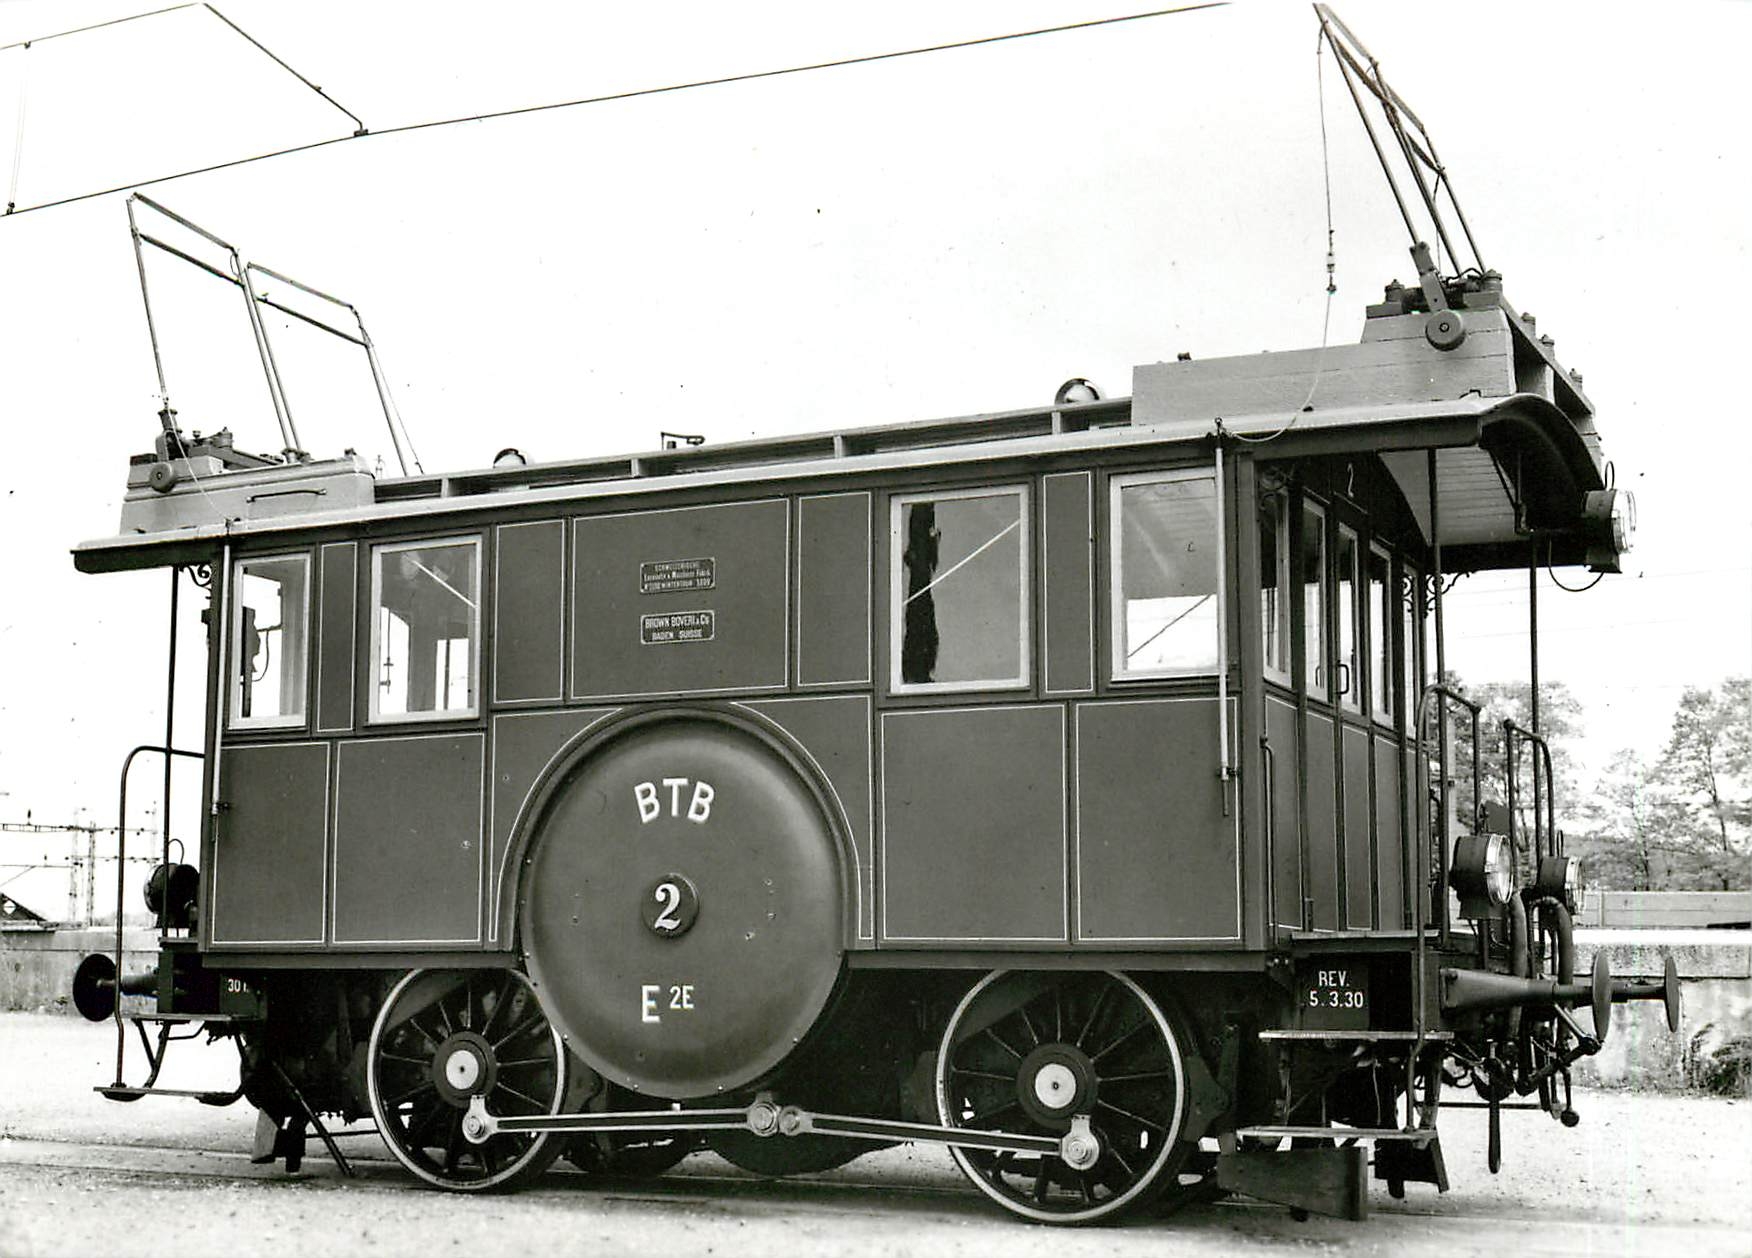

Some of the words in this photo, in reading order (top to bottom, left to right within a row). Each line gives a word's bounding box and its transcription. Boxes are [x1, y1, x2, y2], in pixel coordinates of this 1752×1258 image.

[645, 617, 670, 629] BROWN
[670, 615, 695, 627] BOVERI
[652, 631, 674, 641] BADEN
[678, 629, 702, 639] SUISSE
[634, 778, 715, 823] BTB
[654, 883, 681, 931] 2
[227, 978, 241, 992] 30
[1318, 970, 1350, 987] REV.
[641, 985, 660, 1022] E
[669, 985, 694, 1009] 2E
